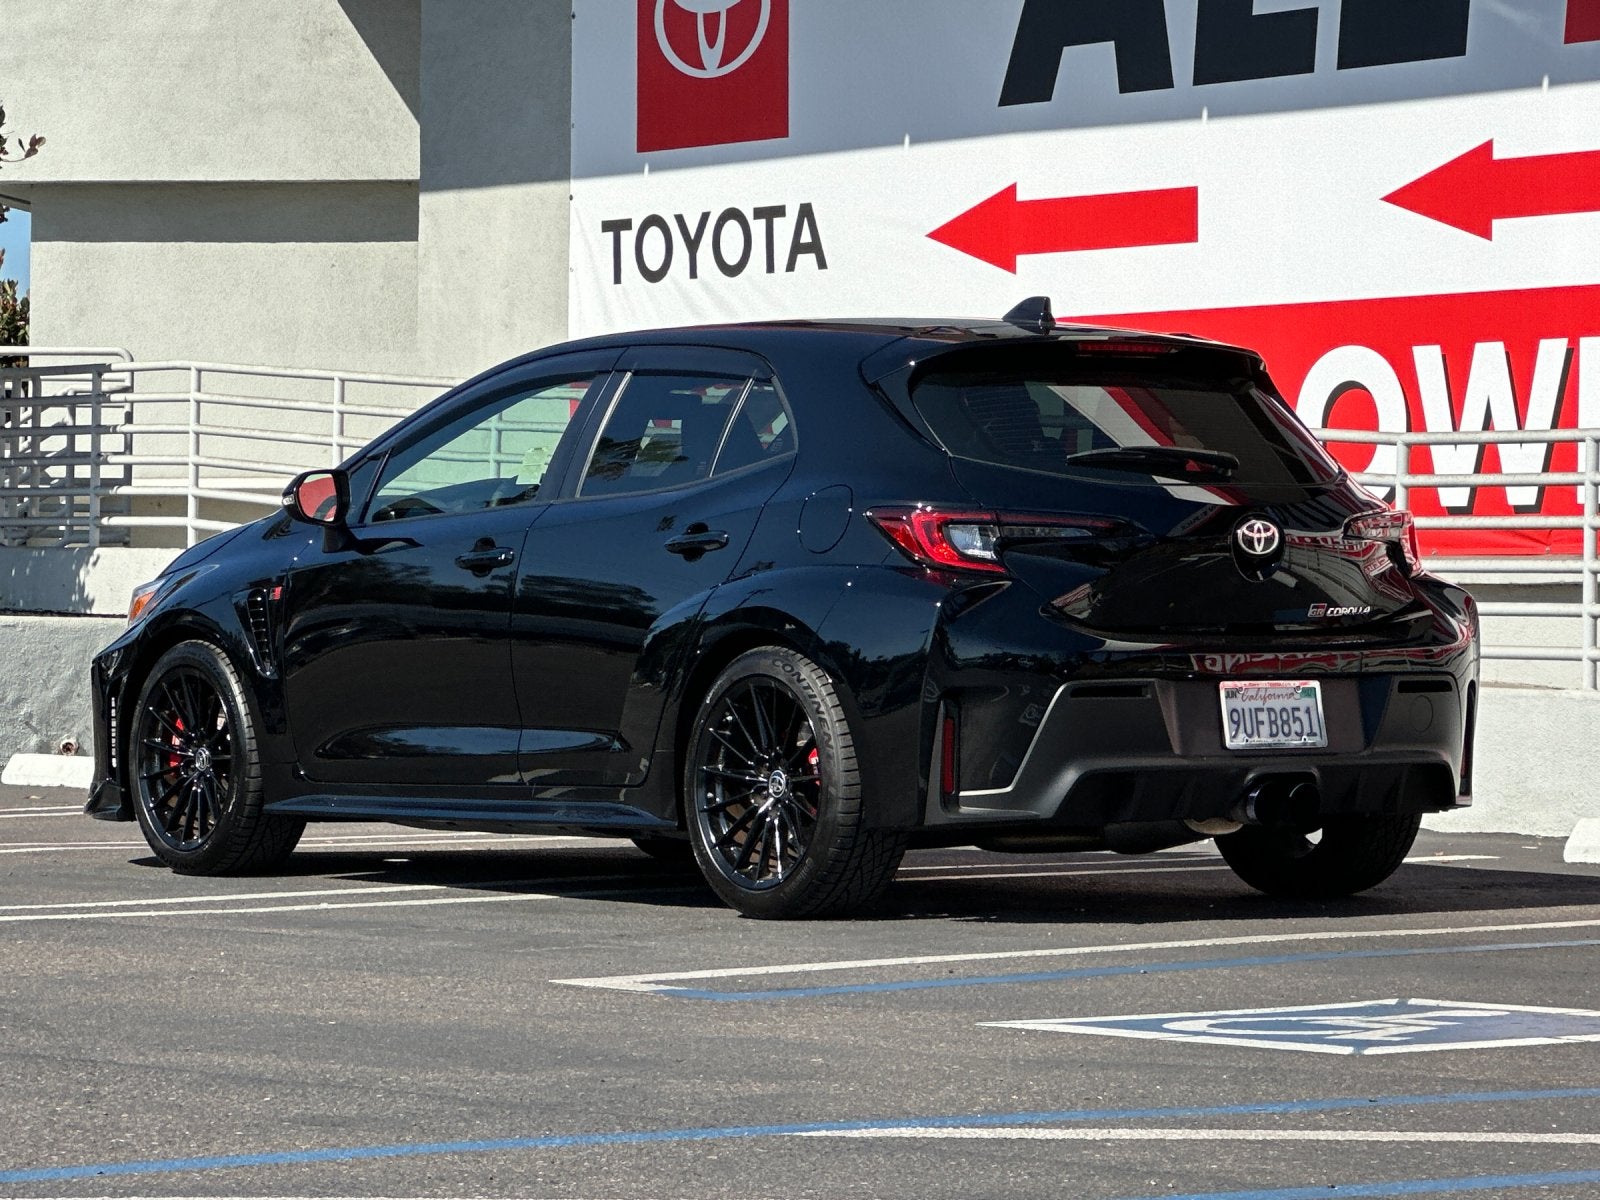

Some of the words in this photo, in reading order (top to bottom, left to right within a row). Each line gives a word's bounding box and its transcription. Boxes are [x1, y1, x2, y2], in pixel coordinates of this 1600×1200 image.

[601, 202, 828, 285] TOYOTA
[1295, 336, 1600, 515] OW
[1230, 707, 1317, 739] 9UFB851
[1241, 685, 1300, 705] California
